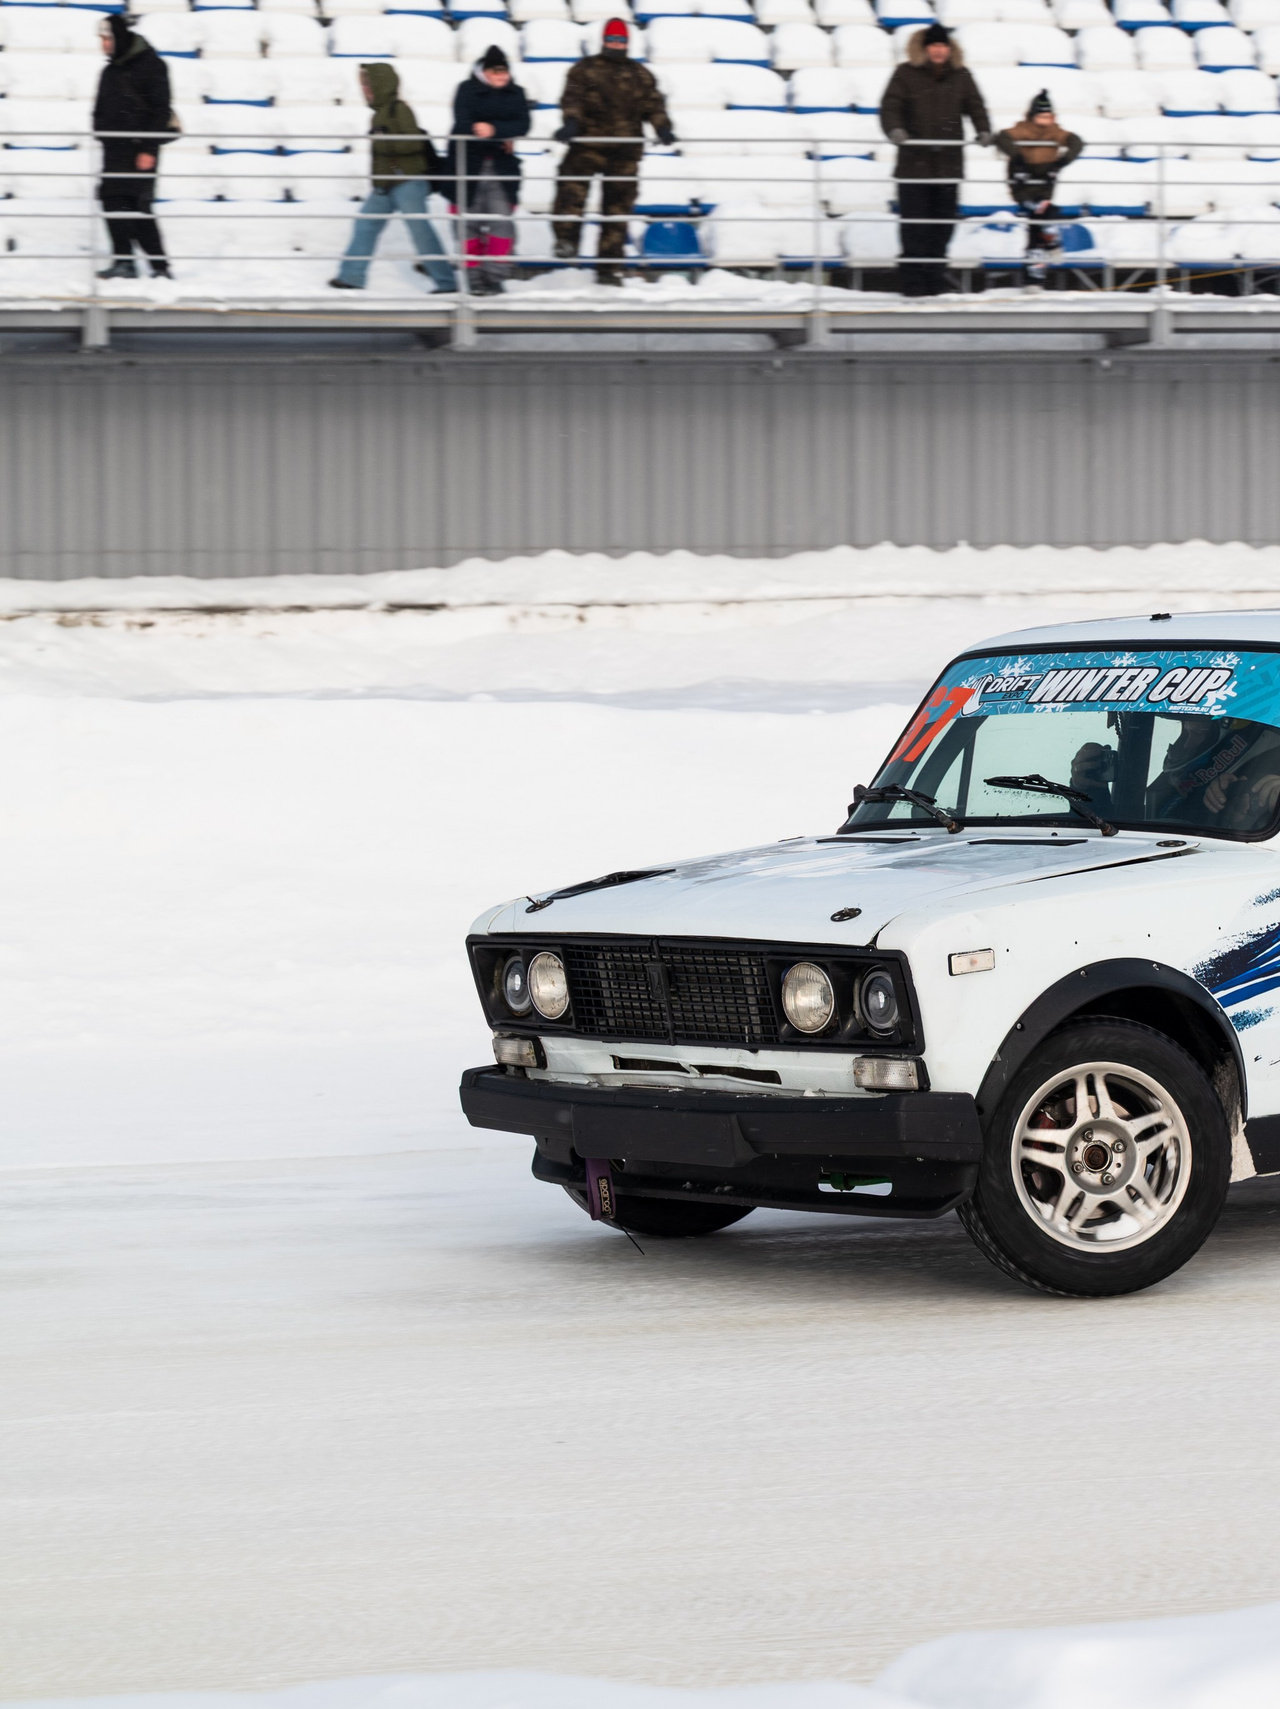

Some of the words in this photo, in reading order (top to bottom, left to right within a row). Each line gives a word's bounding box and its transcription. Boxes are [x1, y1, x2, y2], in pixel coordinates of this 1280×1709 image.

[985, 675, 1043, 693] DRIFT
[1028, 668, 1161, 702] WINTER
[1147, 667, 1233, 703] CUP
[1195, 756, 1227, 784] Red
[1219, 734, 1248, 766] Bull
